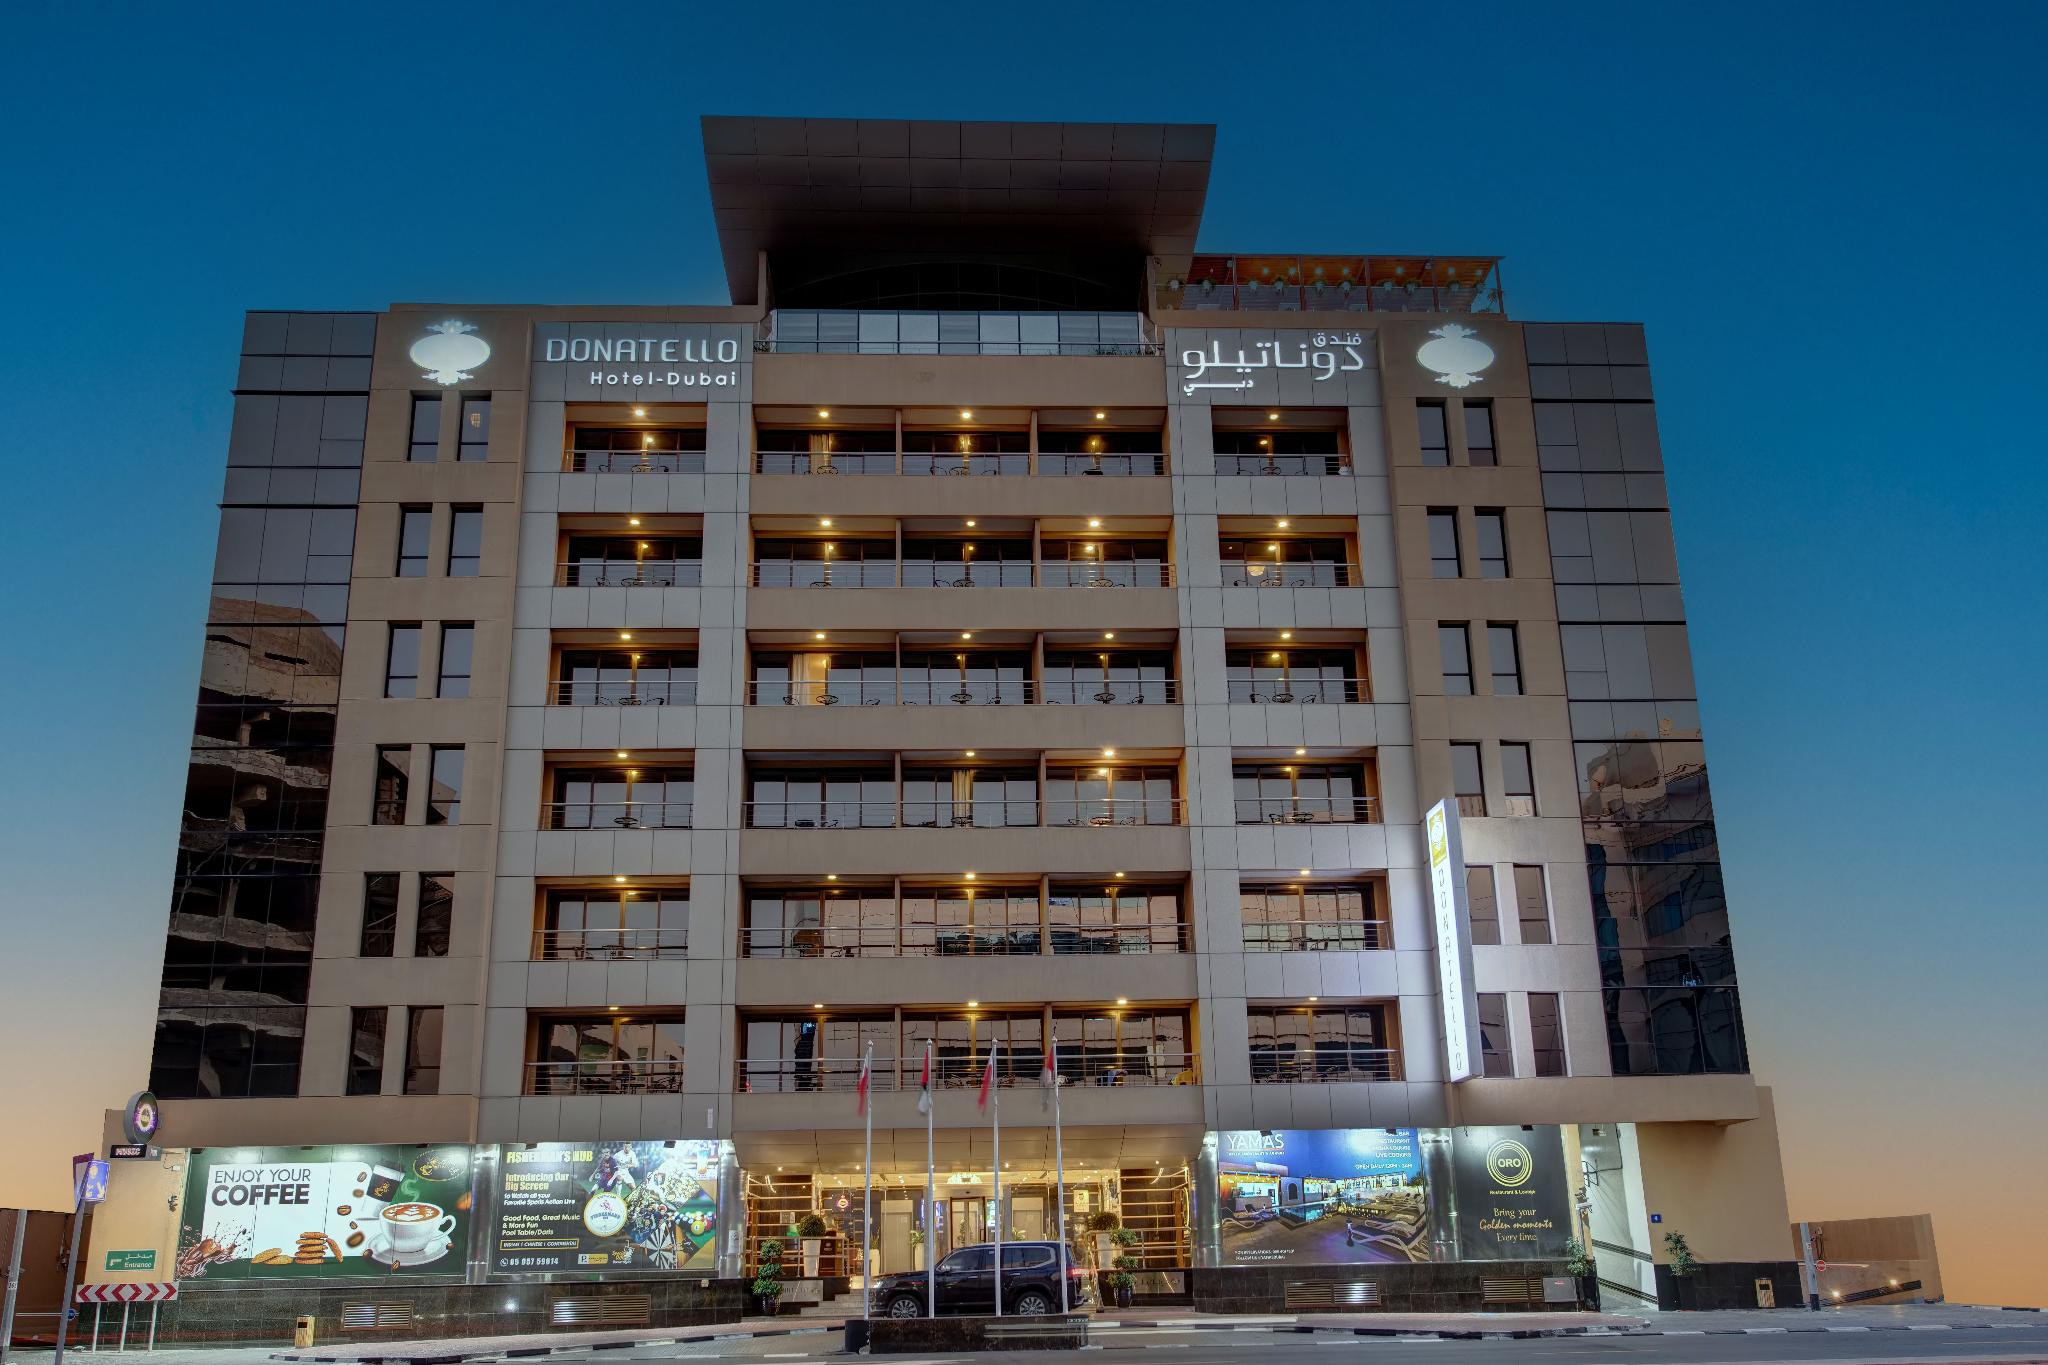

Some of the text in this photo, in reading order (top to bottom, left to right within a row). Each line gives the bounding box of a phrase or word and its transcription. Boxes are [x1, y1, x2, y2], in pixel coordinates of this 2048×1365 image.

[1312, 332, 1362, 348] فندق
[545, 338, 738, 363] DONATELLO
[1182, 340, 1365, 381] دوناتيلو
[590, 370, 737, 387] Hotel-Dubai
[1183, 378, 1254, 396] دبي
[1226, 1134, 1285, 1149] YAMAS
[572, 1150, 593, 1162] HUB
[1497, 1157, 1522, 1168] ORO
[214, 1168, 311, 1183] ENJOY YOUR
[505, 1172, 569, 1182] Introducing Our
[505, 1181, 549, 1191] Big Screen
[211, 1184, 310, 1206] COFFEE
[522, 1214, 541, 1222] Food,
[1493, 1207, 1537, 1219] Bring your
[1479, 1218, 1553, 1231] Golden moments
[1497, 1232, 1537, 1243] Every time
